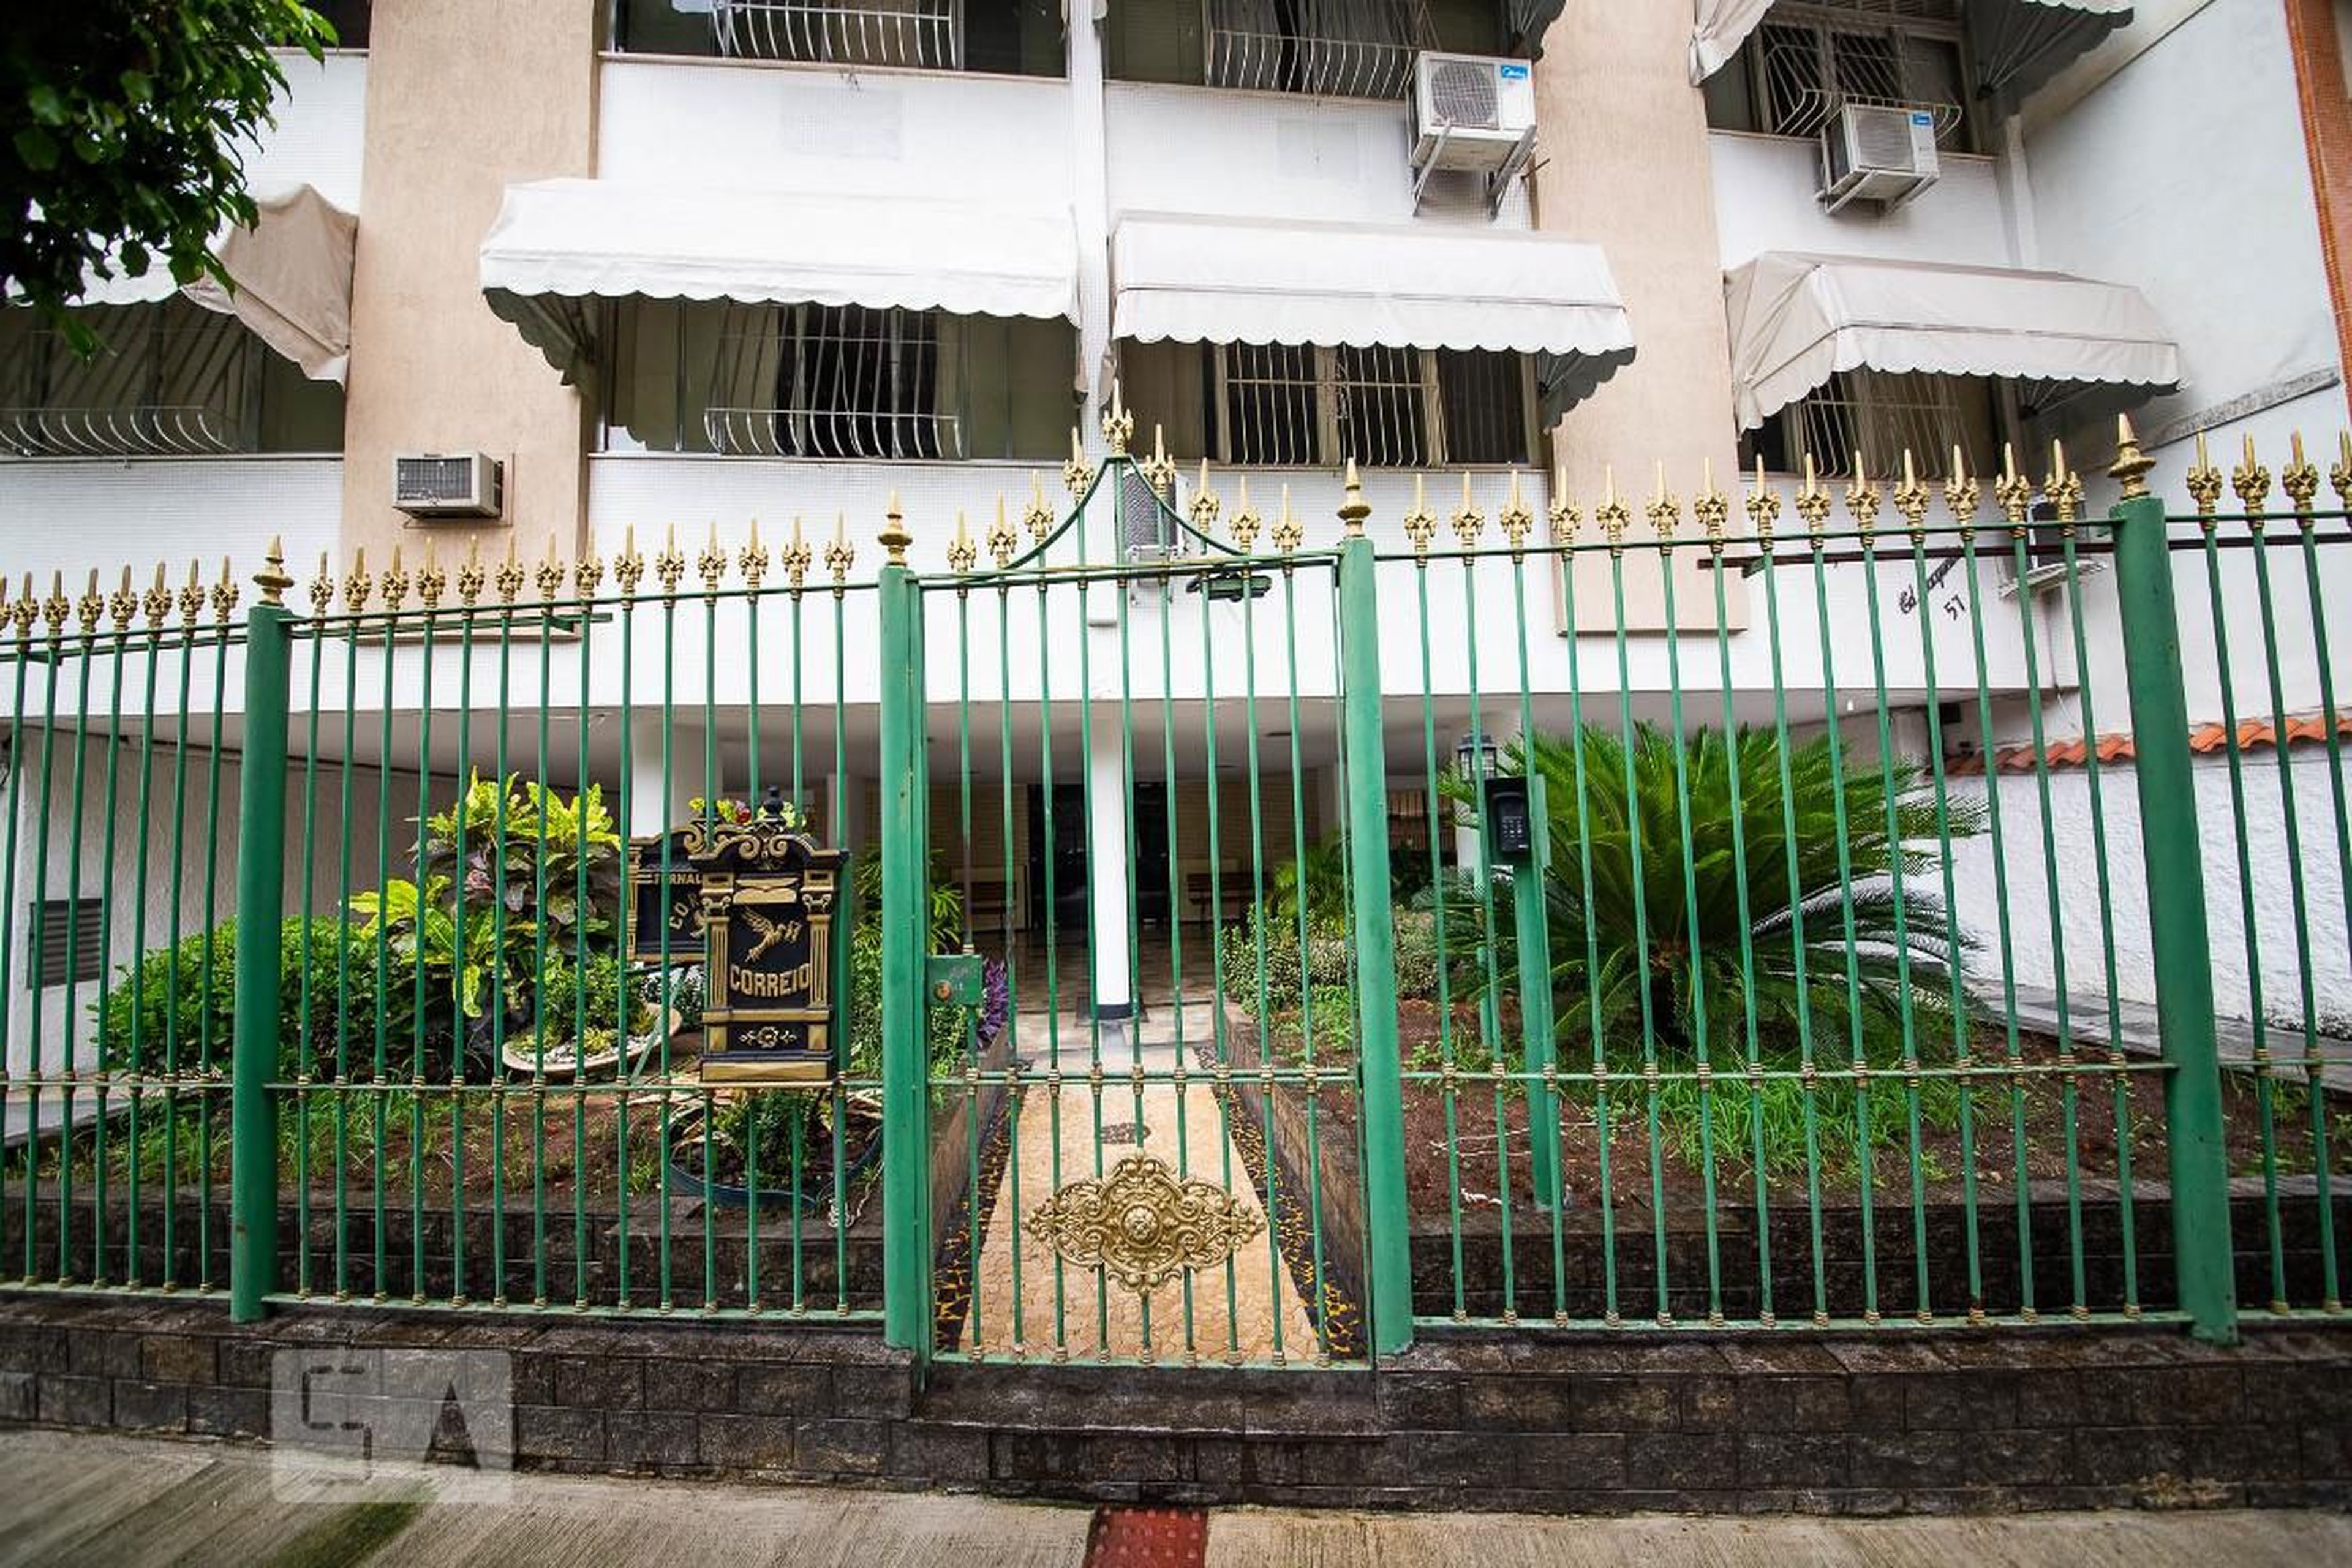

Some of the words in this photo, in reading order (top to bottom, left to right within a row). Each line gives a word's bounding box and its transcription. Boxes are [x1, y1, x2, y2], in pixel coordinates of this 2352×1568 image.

[1943, 594, 1966, 621] 57
[652, 873, 701, 884] JRNAL
[730, 963, 810, 997] CORREIO
